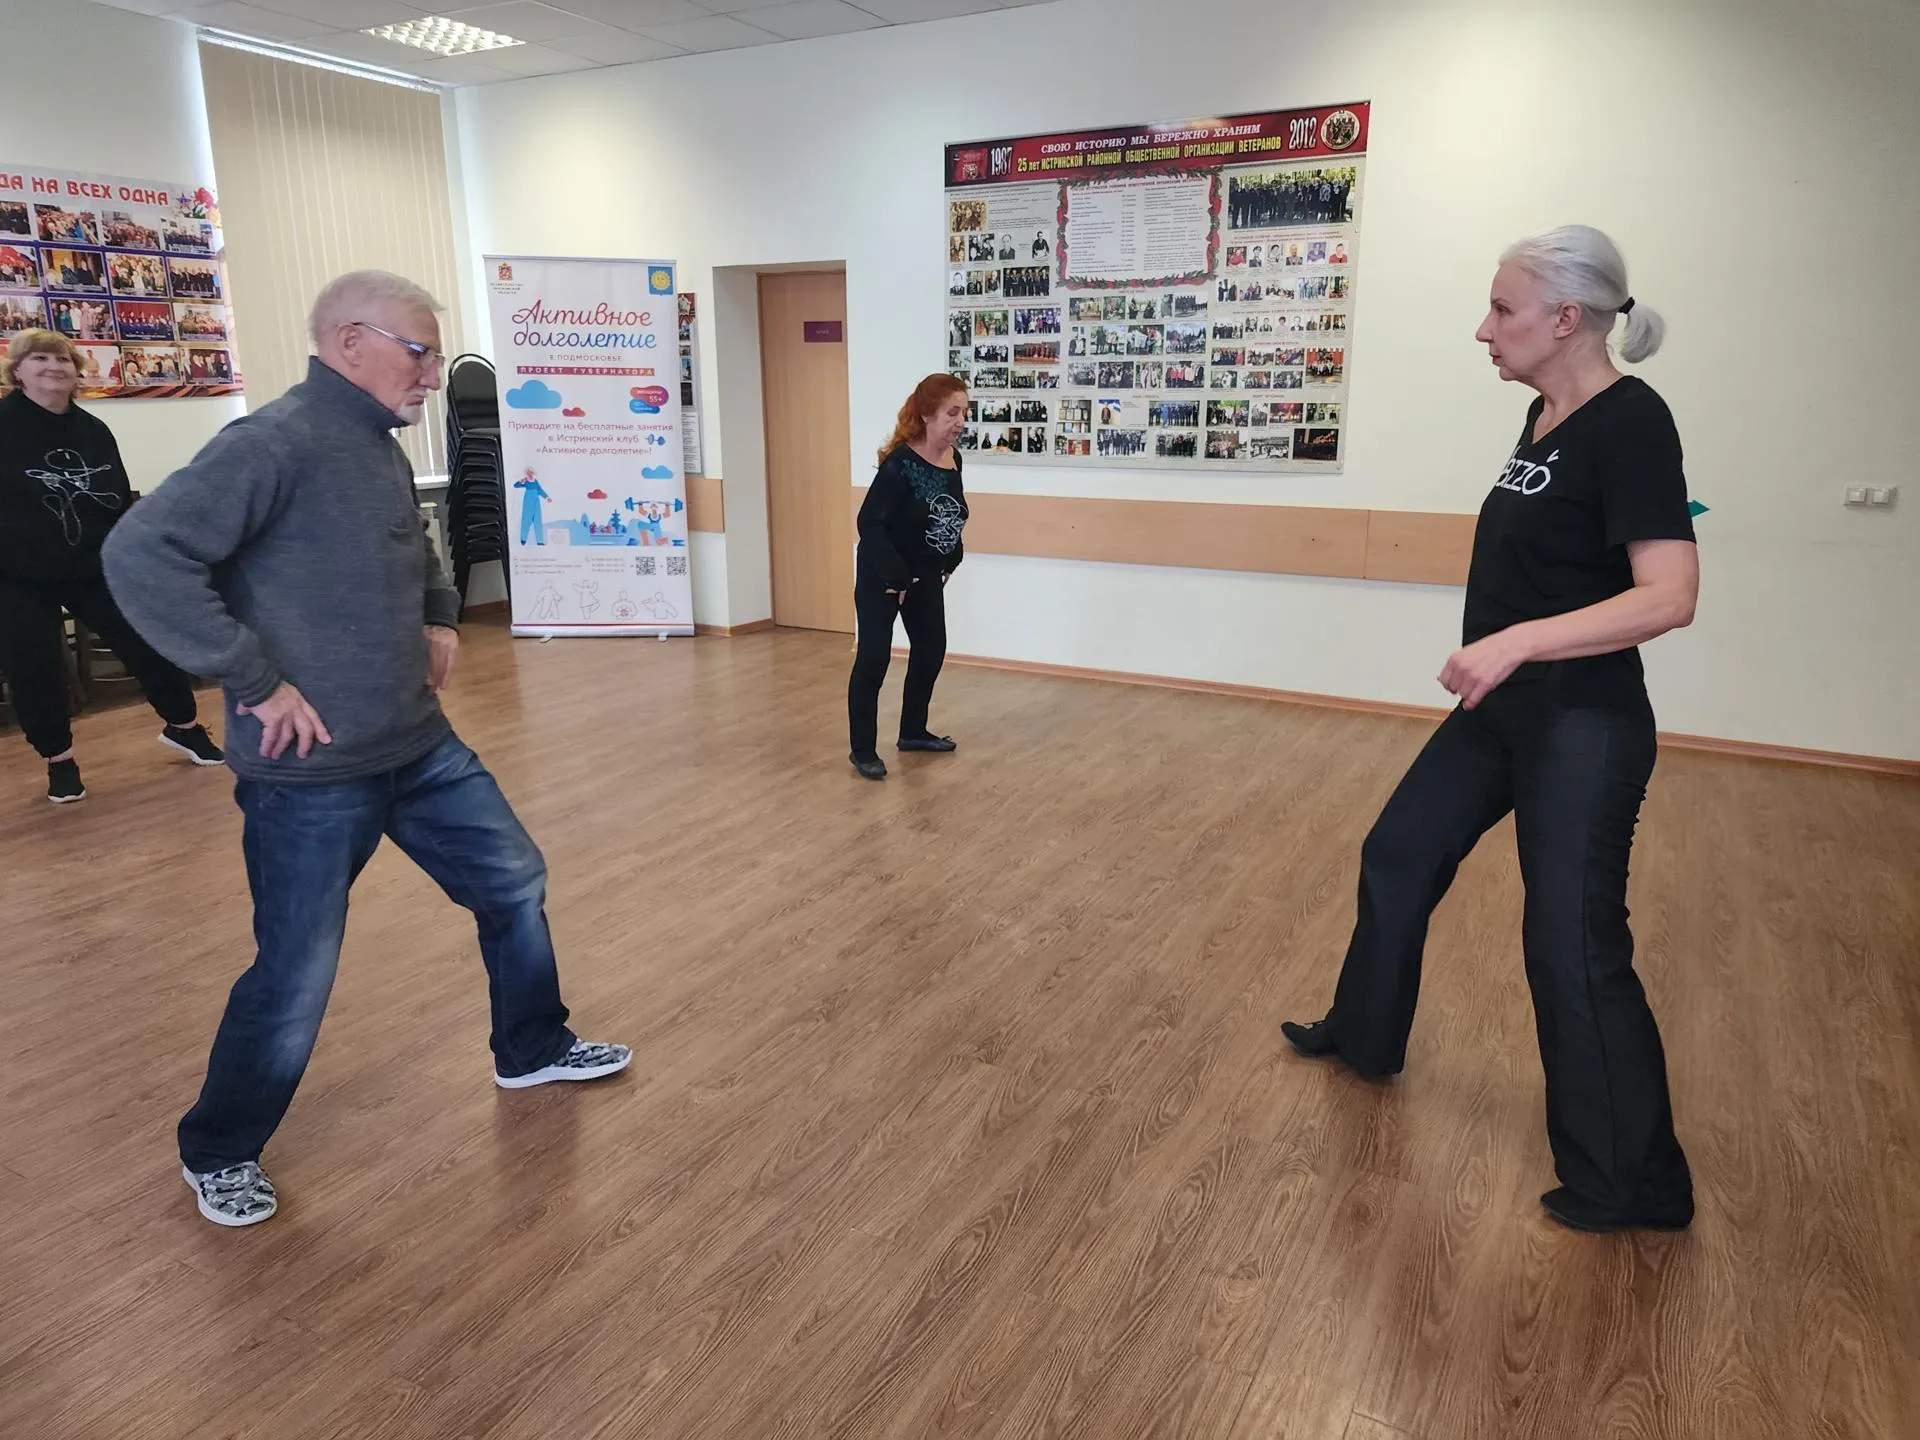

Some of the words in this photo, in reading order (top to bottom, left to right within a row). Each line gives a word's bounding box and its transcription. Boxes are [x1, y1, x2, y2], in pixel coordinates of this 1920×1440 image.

[1041, 142, 1071, 154] СВОЮ
[1075, 137, 1127, 151] ИСТОРИЮ
[1130, 133, 1150, 146] МЫ
[1153, 129, 1209, 143] БЕРЕЖНО
[1213, 123, 1261, 138] ХРАНИМ
[1288, 117, 1318, 150] 2012
[990, 147, 1014, 176] 1987
[1017, 157, 1028, 173] 25
[1029, 160, 1041, 171] лет
[1041, 154, 1084, 170] ИСТРИНСКОЙ
[1087, 149, 1122, 167] РАЙОННОЙ
[1125, 144, 1180, 163] ОБЩЕСТВЕННОЙ
[1184, 140, 1235, 158] ОРГАНИЗАЦИИ
[1238, 136, 1282, 152] ВЕТЕРАНОВ
[31, 176, 59, 193] НА
[66, 180, 112, 199] ВСЕХ
[118, 186, 169, 206] ОДНА
[512, 299, 653, 326] Активное
[513, 322, 658, 348] долголетие
[557, 354, 623, 362] ПОДМОСКОВЬЕ
[572, 368, 655, 376] ГУБЕРНАТОРА
[508, 421, 561, 431] Приходите
[578, 422, 634, 431] бесплатные
[556, 434, 614, 442] Истринский
[616, 435, 639, 443] клуб
[536, 446, 588, 455] «Активное
